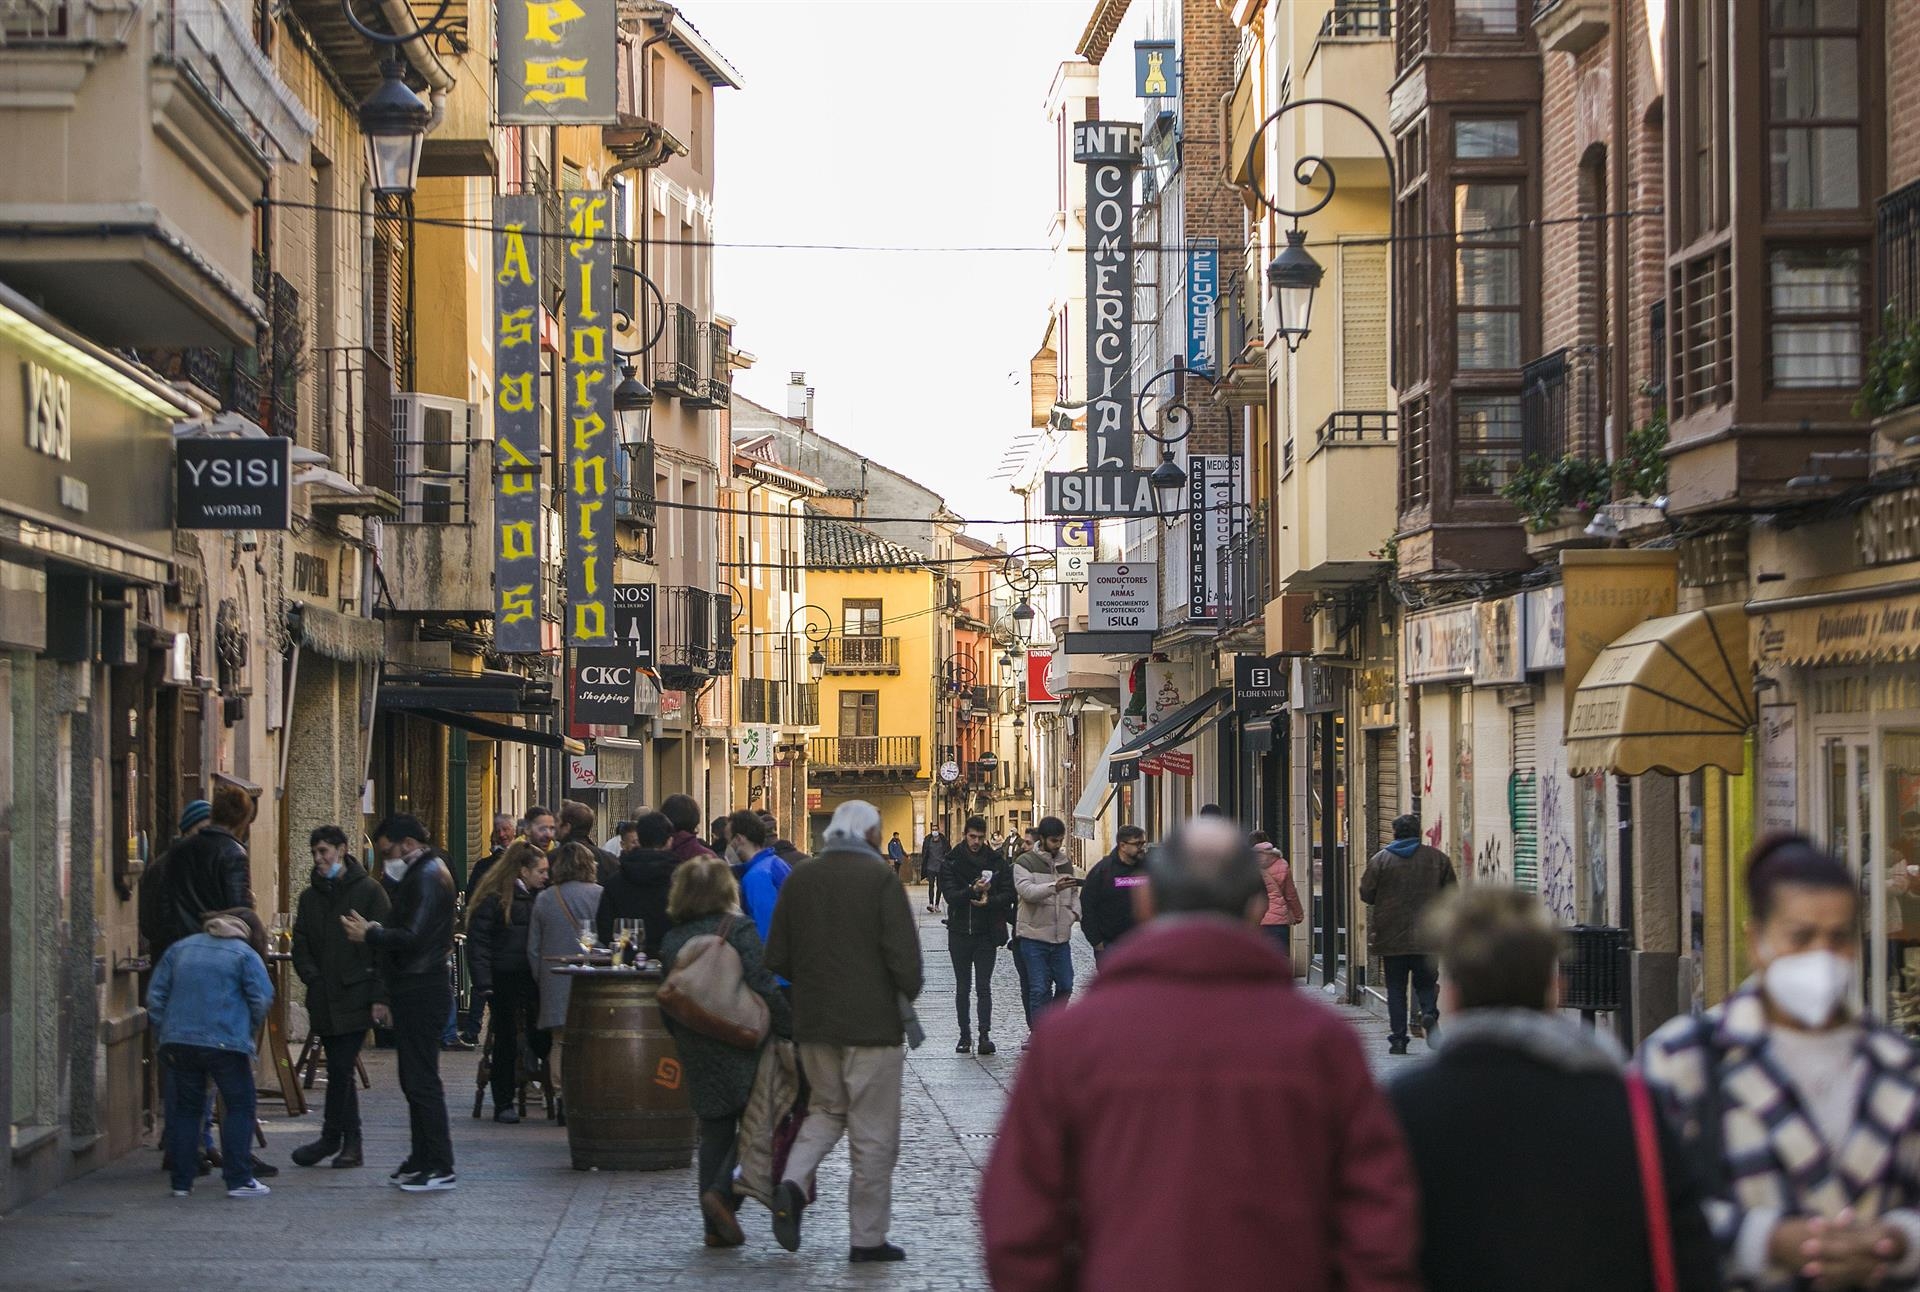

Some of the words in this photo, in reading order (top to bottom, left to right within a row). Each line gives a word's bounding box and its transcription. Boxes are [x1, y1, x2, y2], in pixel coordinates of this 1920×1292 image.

[1093, 165, 1126, 468] COMERCIAL
[498, 222, 535, 624] Asados
[569, 197, 607, 639] Florencio
[184, 458, 279, 487] YSISI
[1052, 476, 1153, 512] ISILLA
[202, 504, 262, 517] woman
[1062, 521, 1088, 547] G
[1193, 461, 1203, 614] RECONOCIMIENTOS
[581, 666, 631, 685] CKC
[579, 691, 630, 704] Shopping
[1238, 690, 1285, 698] FLORENTINO
